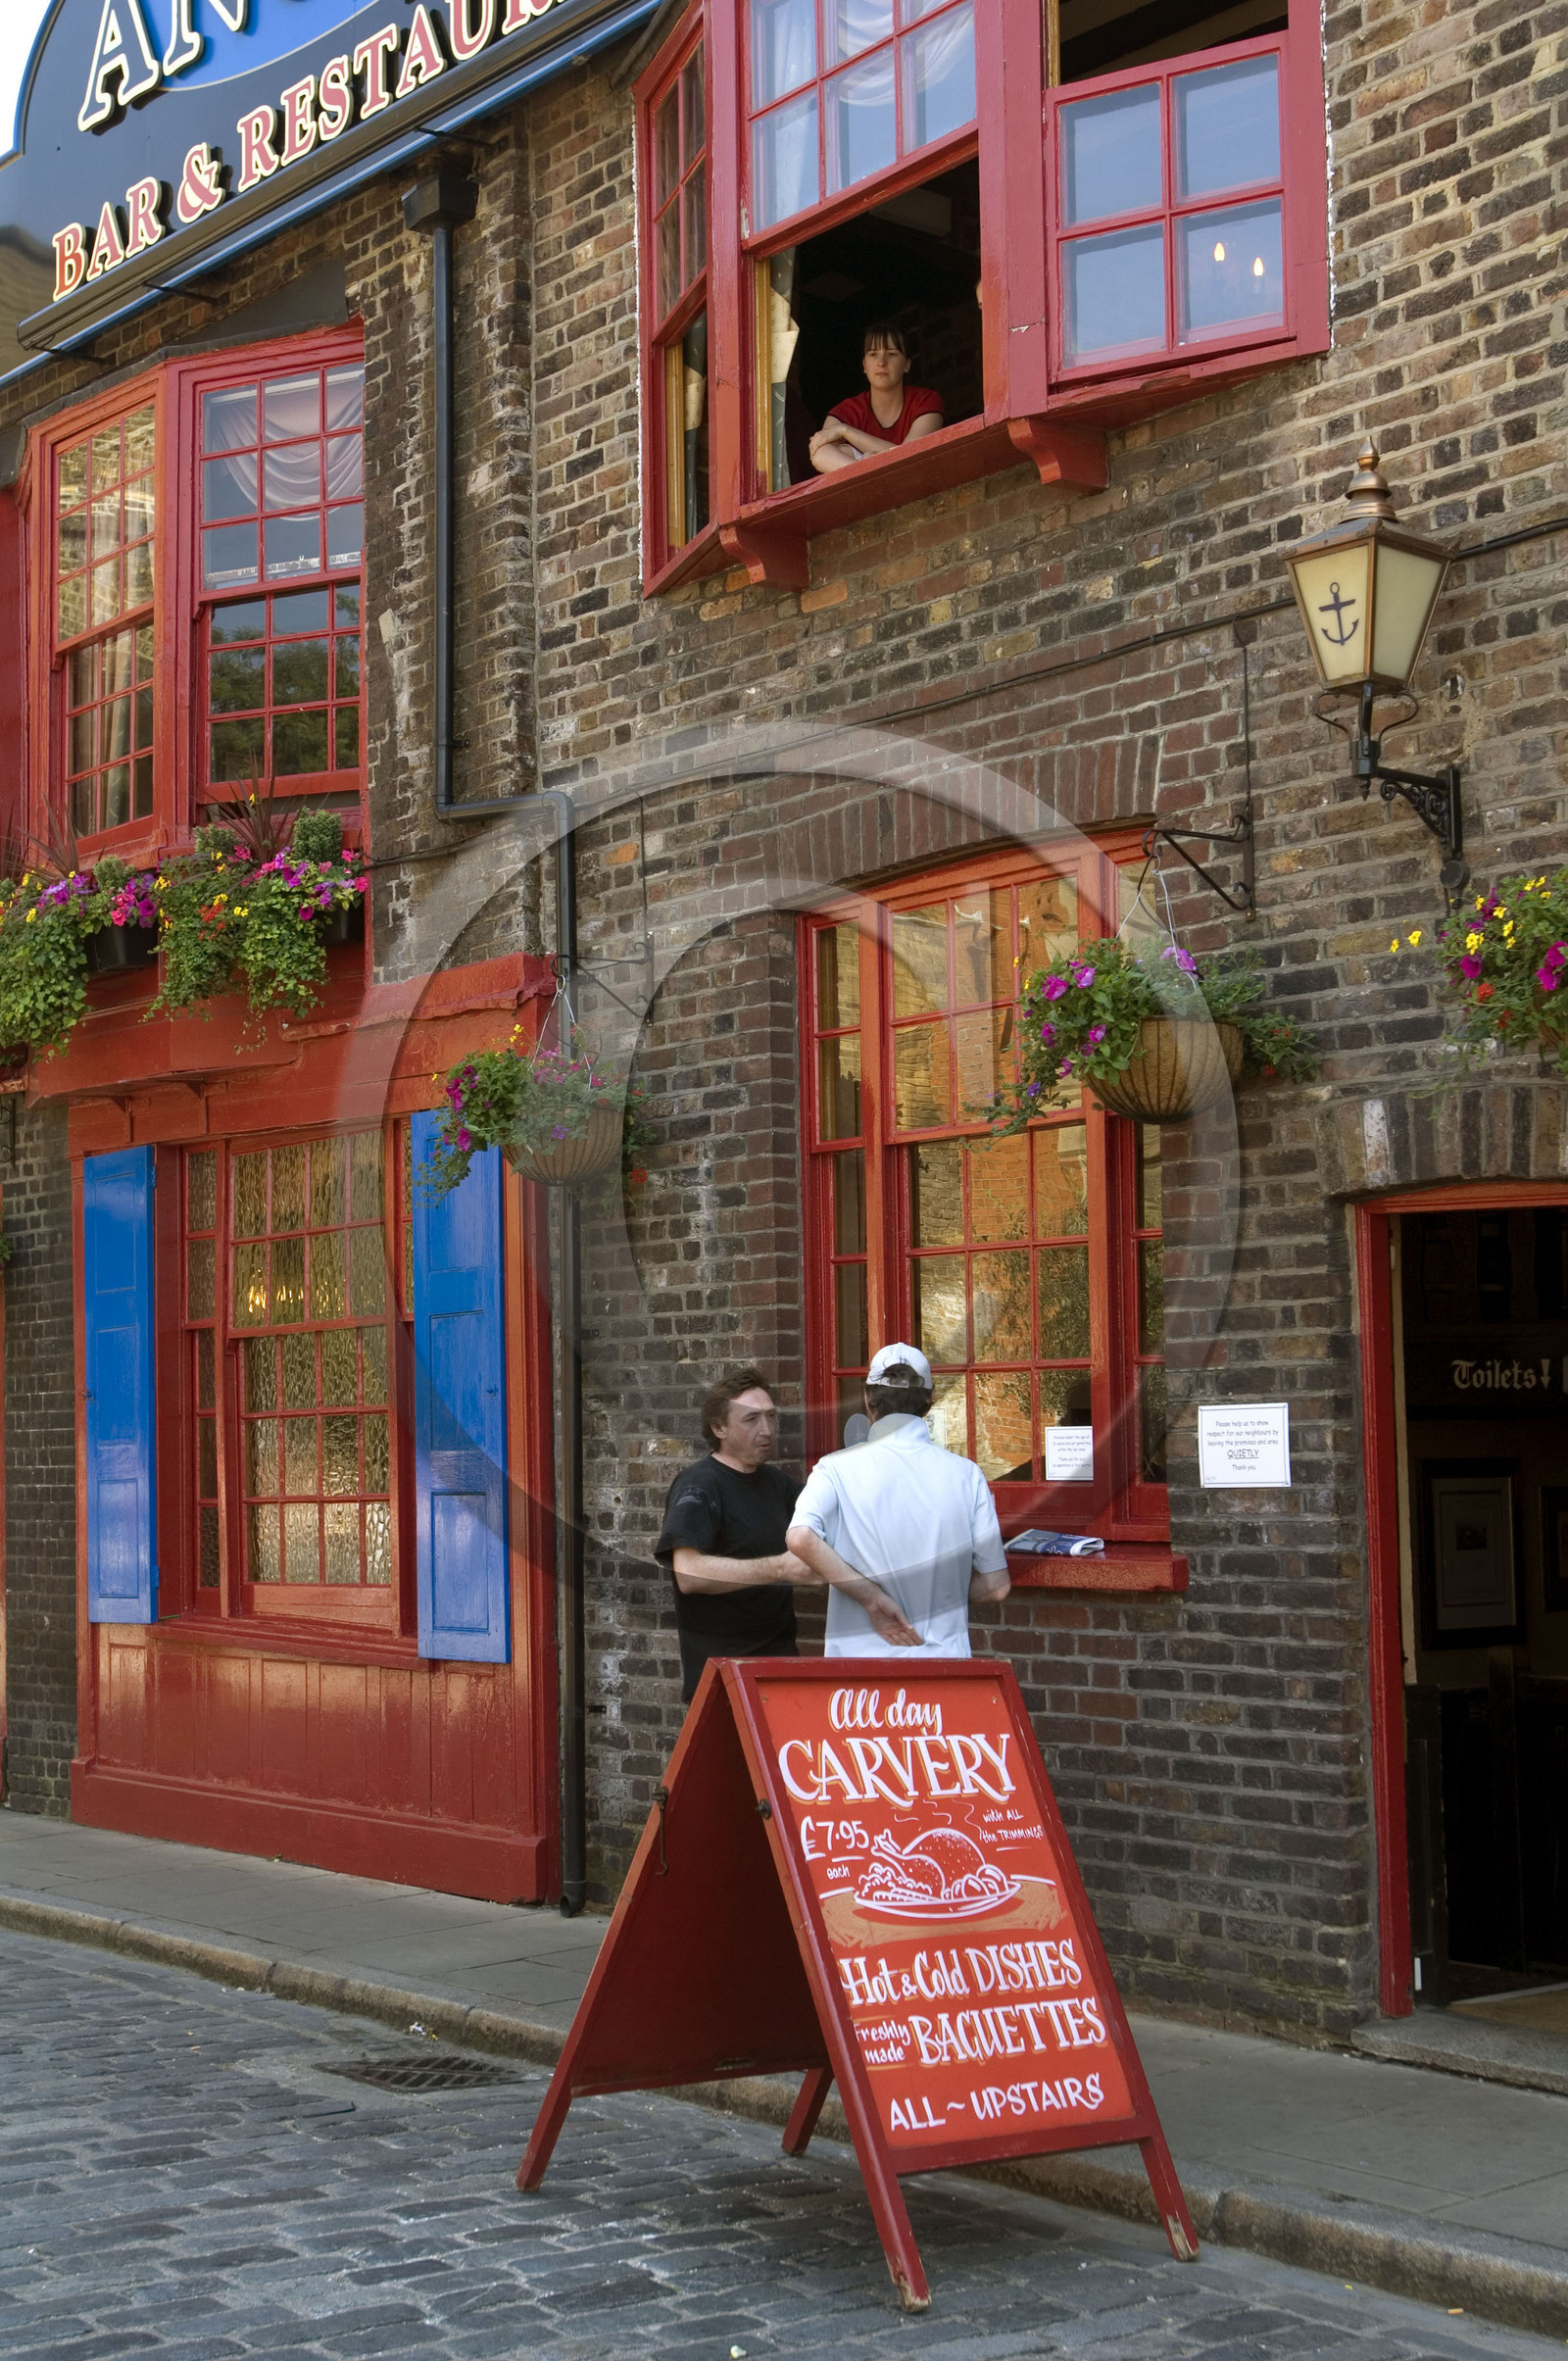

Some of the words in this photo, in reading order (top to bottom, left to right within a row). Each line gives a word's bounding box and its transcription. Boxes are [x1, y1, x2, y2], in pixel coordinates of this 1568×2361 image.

[52, 176, 166, 302] BAR
[176, 141, 226, 223] &
[1227, 1449, 1259, 1458] QUIETLY
[886, 1688, 942, 1736] day
[778, 1733, 1016, 1809] CARVERY
[982, 1829, 996, 1844] the
[998, 1825, 1044, 1843] TRIMMINGS
[983, 1808, 1004, 1823] with
[1006, 1808, 1024, 1820] ALL
[826, 1864, 850, 1880] each
[840, 1956, 901, 2007] Hot
[901, 1973, 918, 1999] &
[912, 1949, 970, 2000] Cold
[965, 1939, 1083, 1994] DISHES
[864, 2044, 906, 2065] made
[907, 1996, 1107, 2067] BAGUETTES
[890, 2095, 946, 2132] ALL
[970, 2073, 1104, 2120] UPSTAIRS
